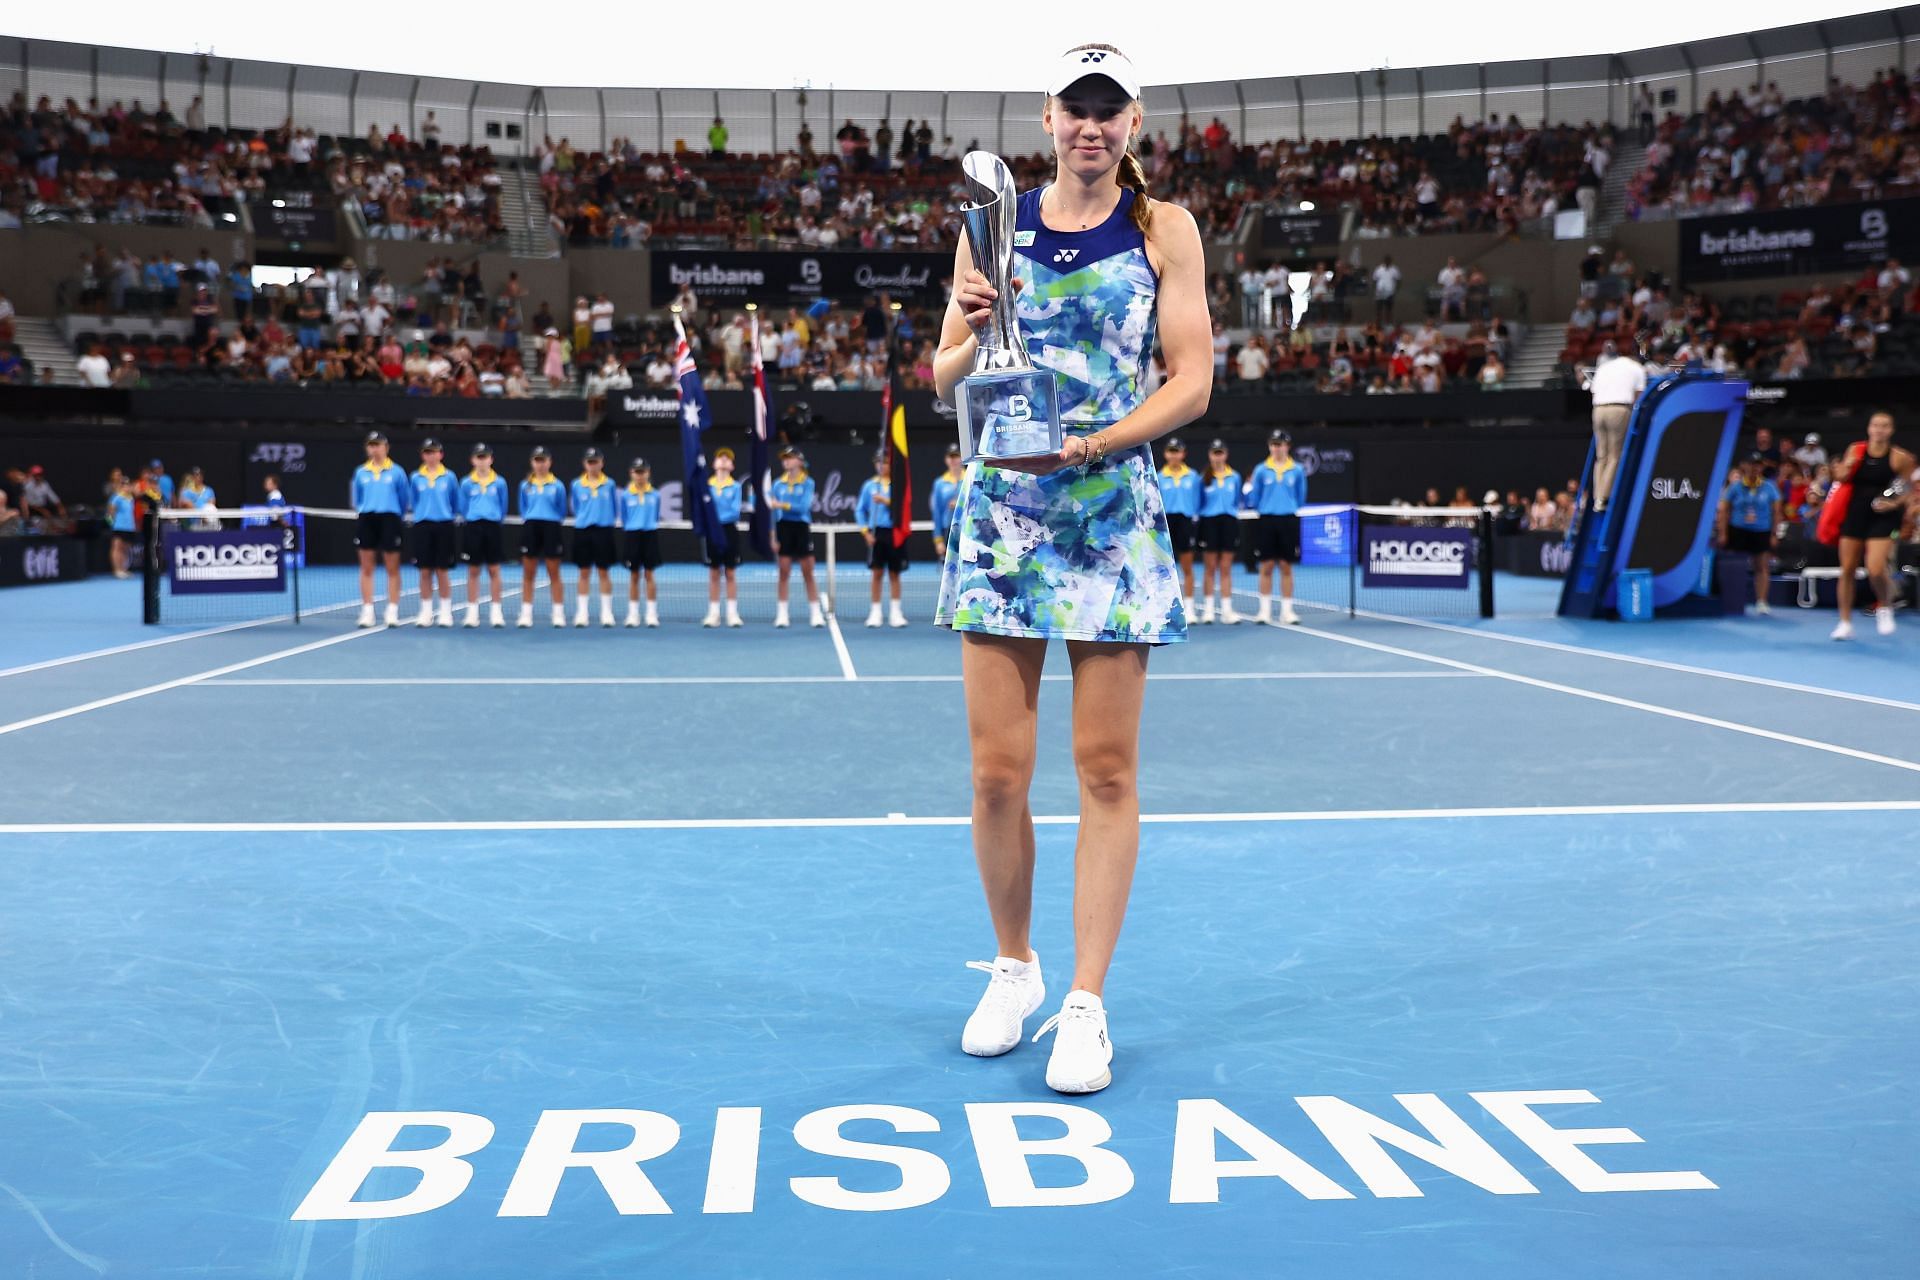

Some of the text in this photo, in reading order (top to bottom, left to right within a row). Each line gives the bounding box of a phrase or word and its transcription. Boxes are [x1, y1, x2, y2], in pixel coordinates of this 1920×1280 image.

[1700, 227, 1814, 255] brisbane
[670, 263, 764, 285] brisbane
[693, 286, 747, 296] ustralia
[624, 396, 680, 411] brisban
[250, 443, 305, 463] ATP
[175, 544, 278, 567] HOLOGIC
[1370, 541, 1464, 562] HOLOGIC
[290, 1088, 1720, 1222] BRISBANE
